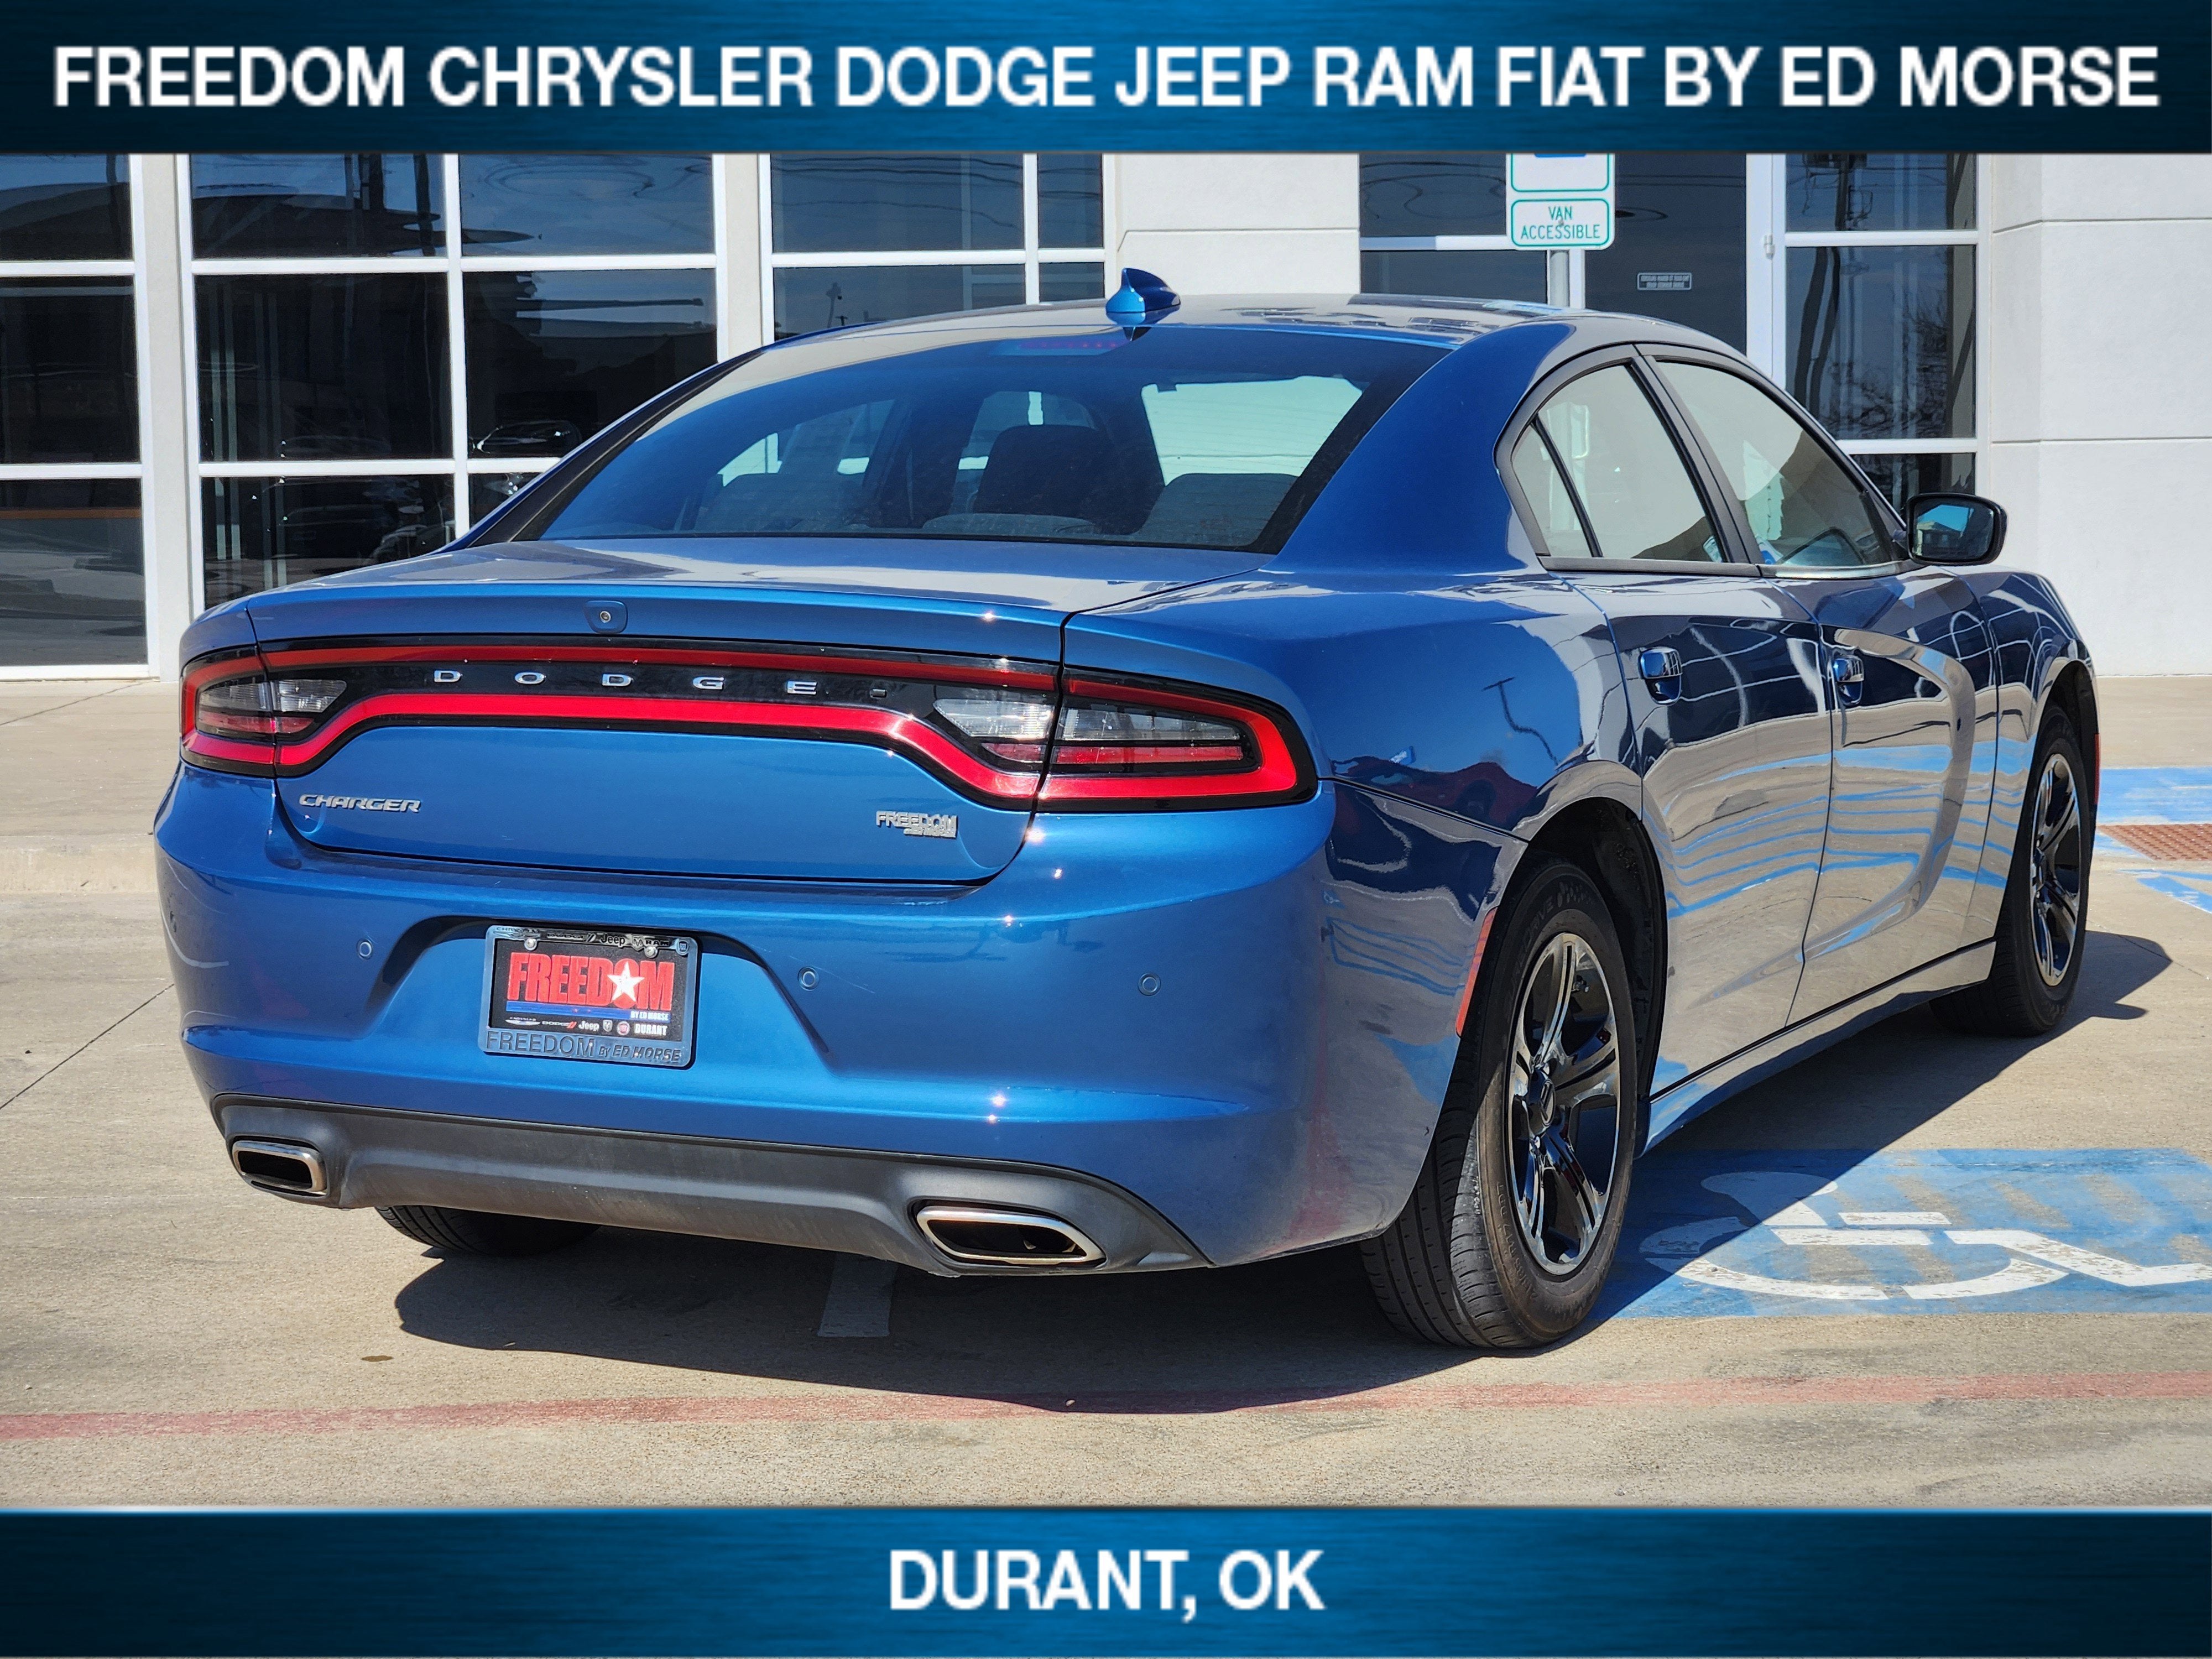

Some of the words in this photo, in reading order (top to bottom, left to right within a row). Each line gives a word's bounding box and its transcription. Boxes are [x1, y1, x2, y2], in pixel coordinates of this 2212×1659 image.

[1548, 206, 1572, 220] VAN
[1520, 224, 1600, 239] ACCESSIBLE
[433, 669, 818, 696] DODGE
[299, 794, 421, 812] CHARGER
[876, 810, 957, 831] FREEDOM
[600, 932, 626, 947] Jeep
[507, 952, 675, 1011] FREEDOM
[578, 1020, 600, 1032] Jeep
[634, 1023, 668, 1036] DURANT
[486, 1031, 595, 1057] FREEDOM
[612, 1045, 630, 1057] ED
[631, 1046, 681, 1063] MORSE
